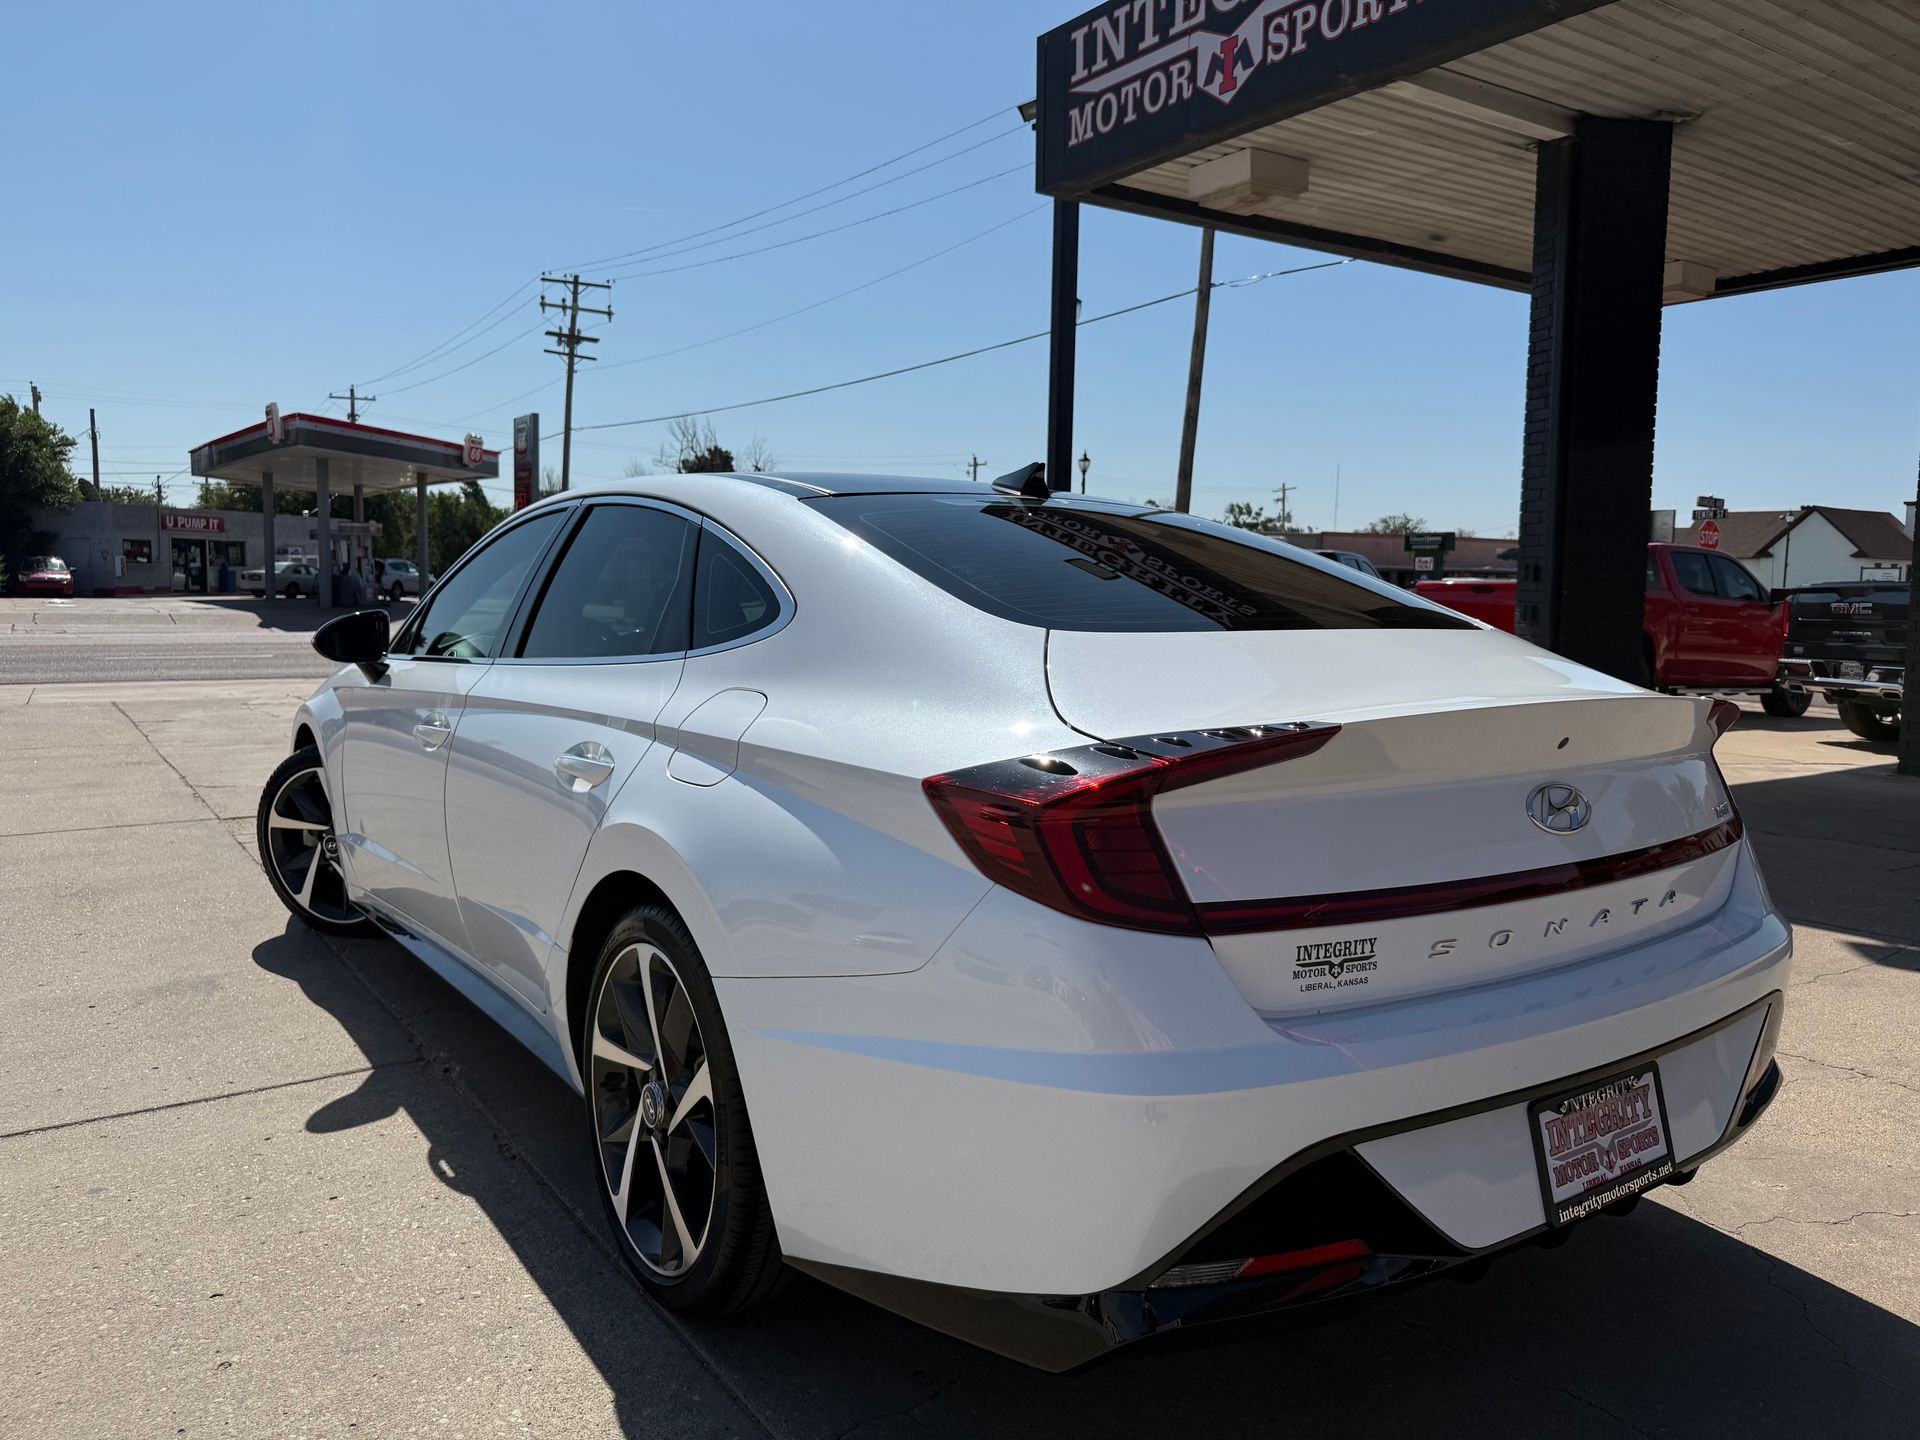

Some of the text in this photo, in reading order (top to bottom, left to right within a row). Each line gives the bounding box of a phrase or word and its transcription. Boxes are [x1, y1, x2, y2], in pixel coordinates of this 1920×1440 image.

[1068, 58, 1193, 147] MOTOR
[165, 515, 174, 527] U
[177, 516, 207, 529] PUMP
[1700, 531, 1719, 545] STOP
[1428, 889, 1677, 959] SONATA
[1292, 961, 1378, 980] MOTOR SPORTS
[1296, 937, 1378, 962] INTEGRITY
[1300, 976, 1369, 992] LIBERAL, KANSAS
[1545, 1083, 1652, 1156] INTEGRITY
[1553, 1151, 1600, 1188] MOTOR
[1616, 1126, 1660, 1161] SPORTS
[1558, 1160, 1674, 1224] integritymotorsports.net
